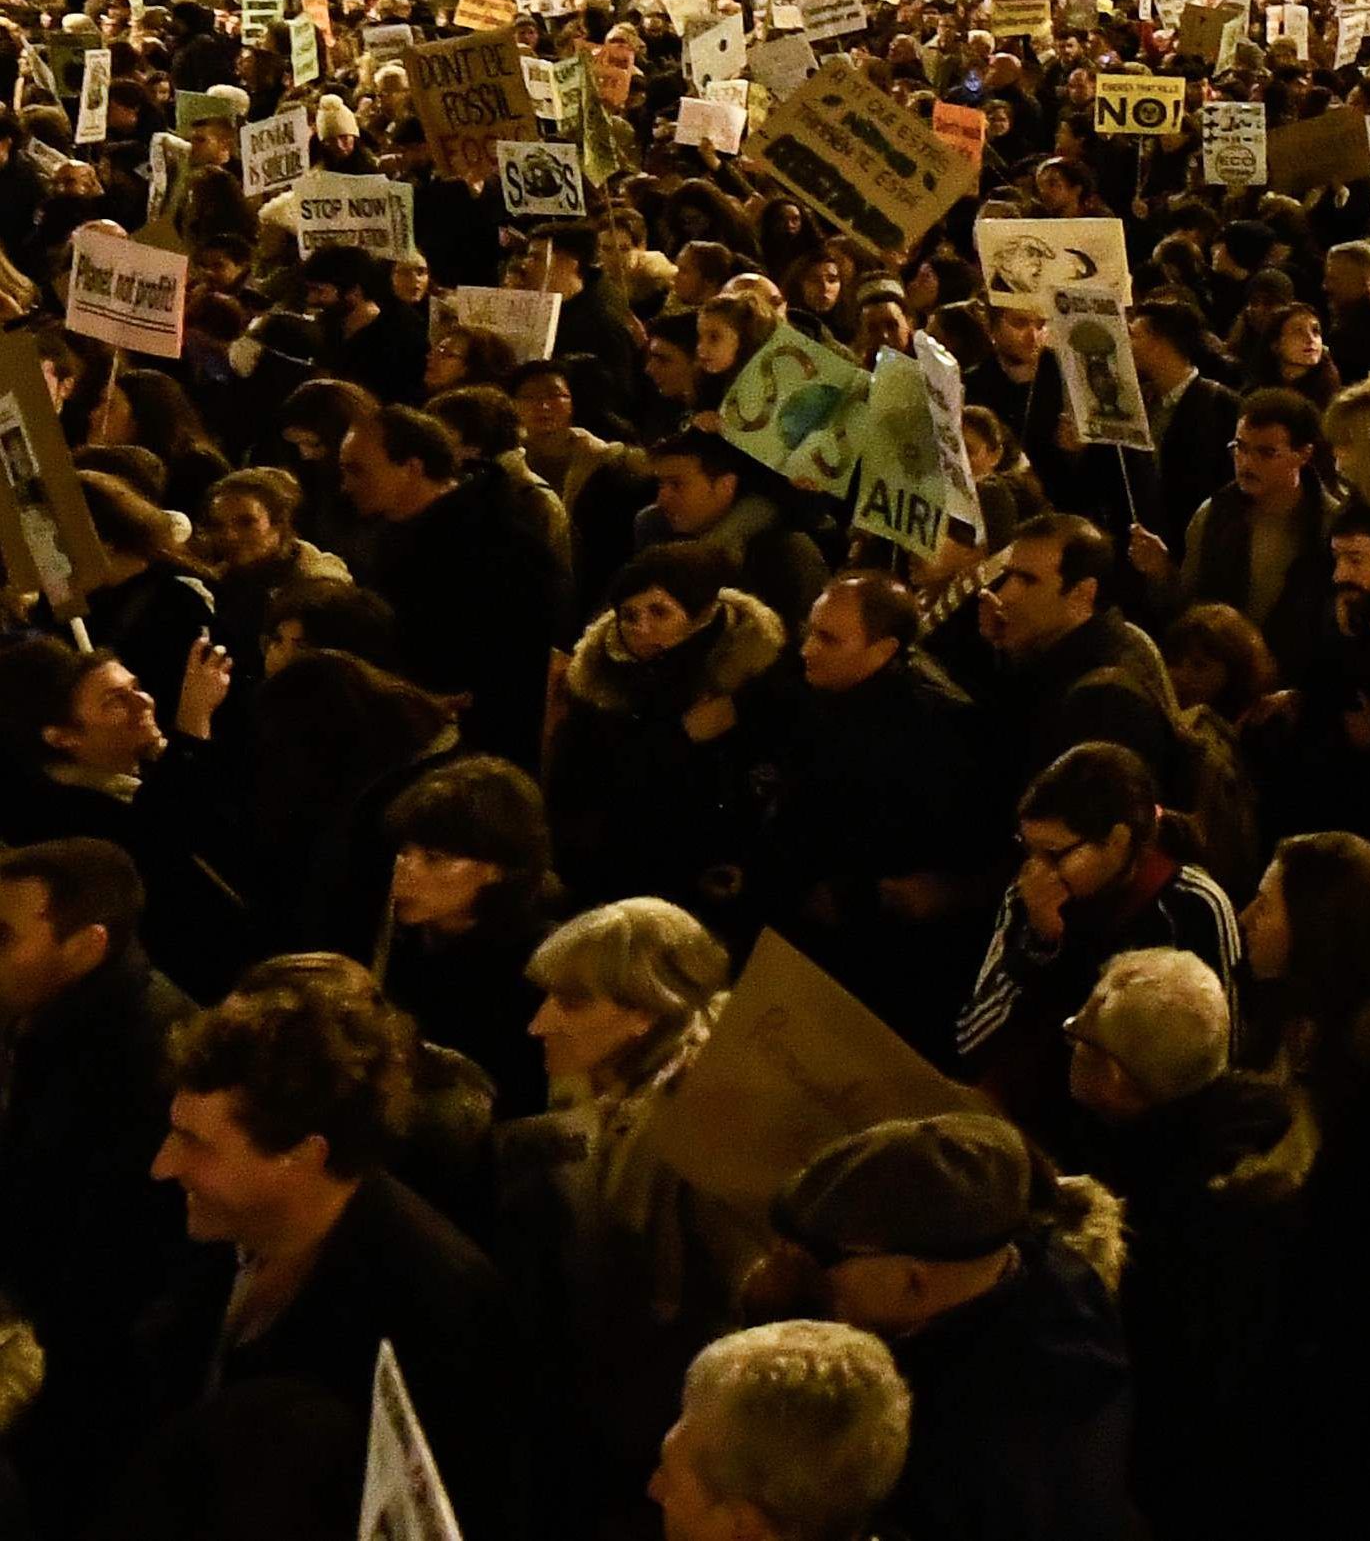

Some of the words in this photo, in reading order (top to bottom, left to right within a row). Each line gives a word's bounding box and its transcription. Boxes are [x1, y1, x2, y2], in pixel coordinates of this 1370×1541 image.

[1097, 96, 1182, 129] NO!
[301, 199, 342, 219] STOP
[348, 197, 387, 218] NOW
